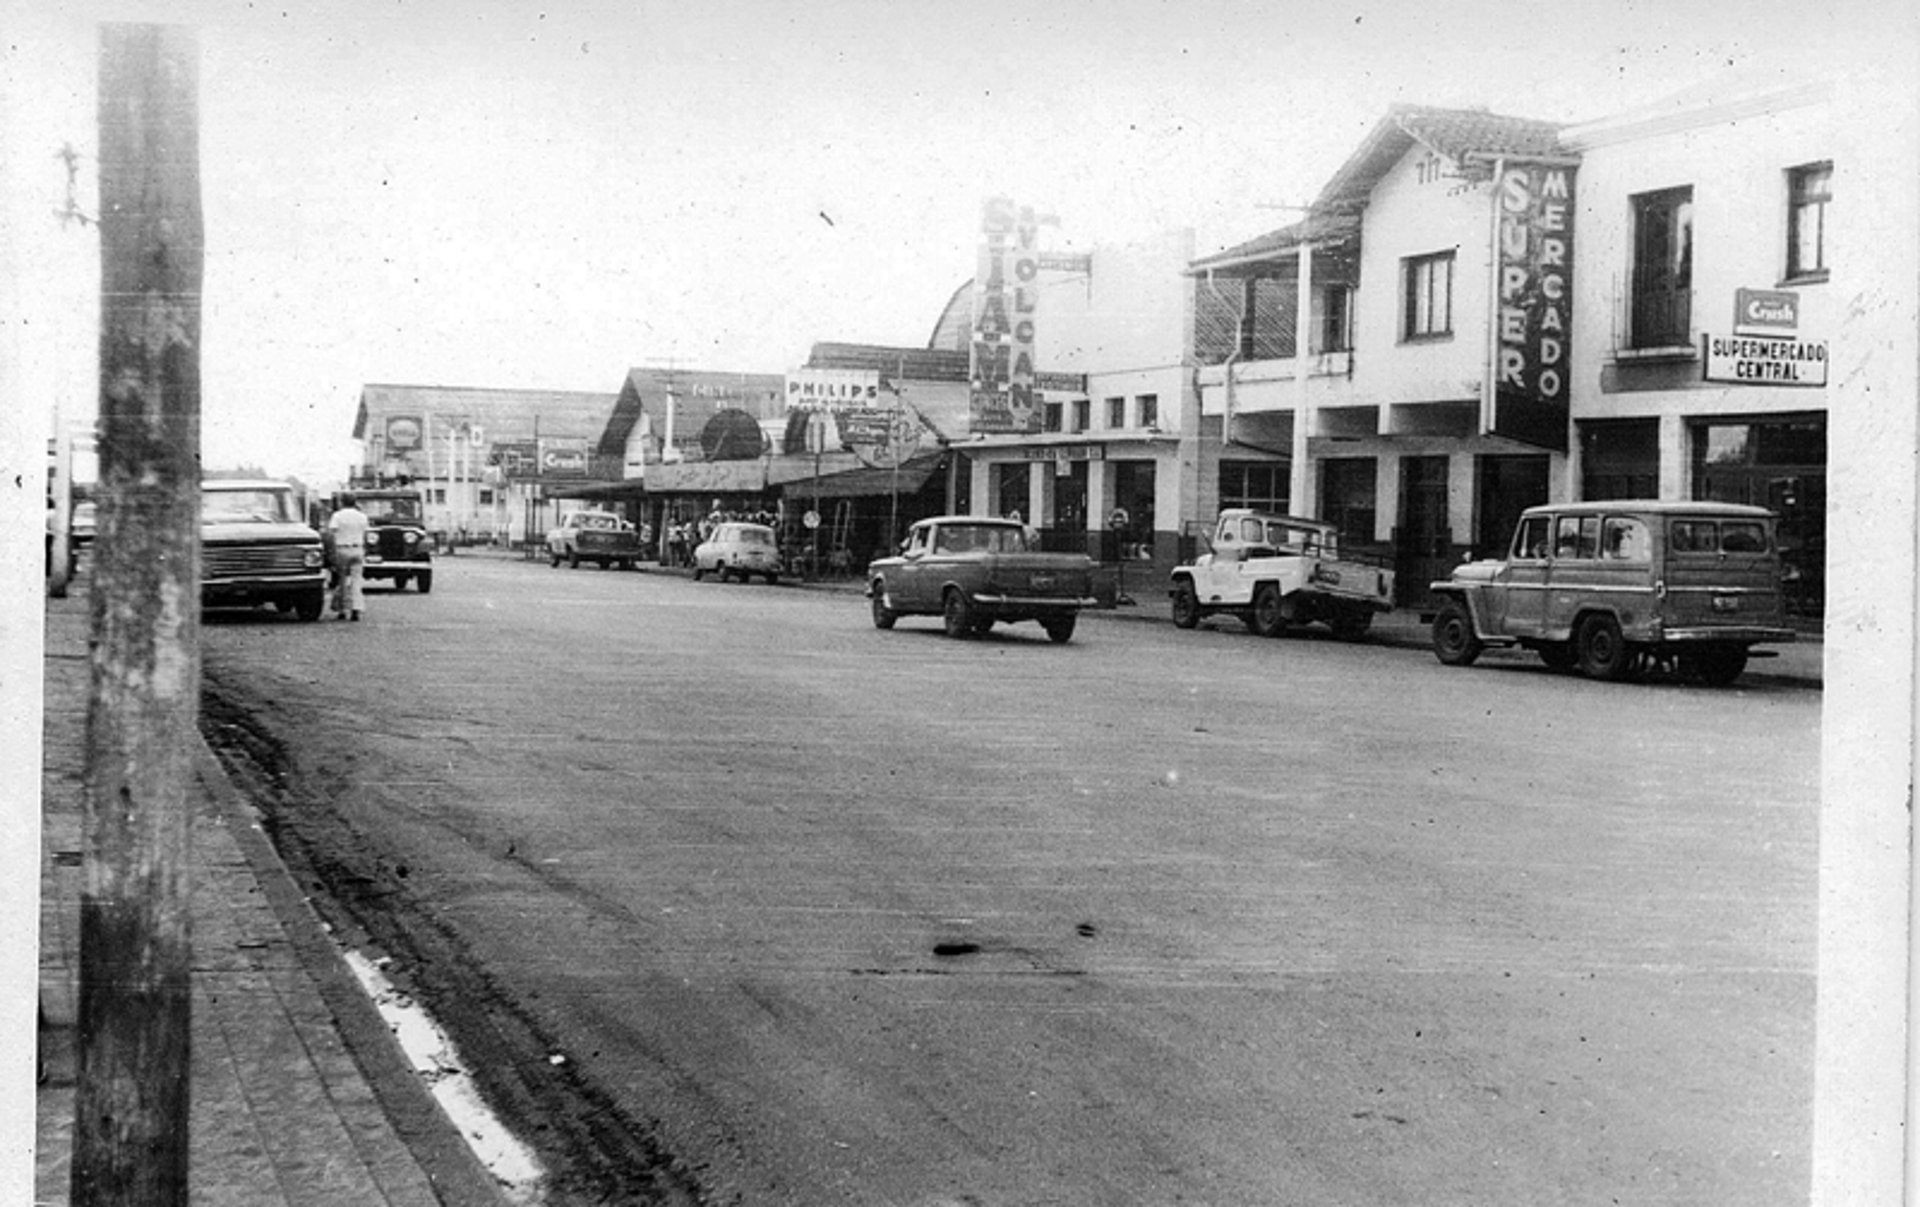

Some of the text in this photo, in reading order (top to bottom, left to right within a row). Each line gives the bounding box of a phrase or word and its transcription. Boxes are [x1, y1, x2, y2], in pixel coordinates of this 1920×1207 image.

[1500, 169, 1530, 389] SUPER
[1539, 171, 1568, 398] MERCADO
[1011, 223, 1037, 408] VOLCAN
[1748, 300, 1794, 321] Crush
[1712, 338, 1823, 361] SUPERMERCADO
[1736, 360, 1799, 380] CENTRAL
[789, 382, 877, 398] PHILIPS
